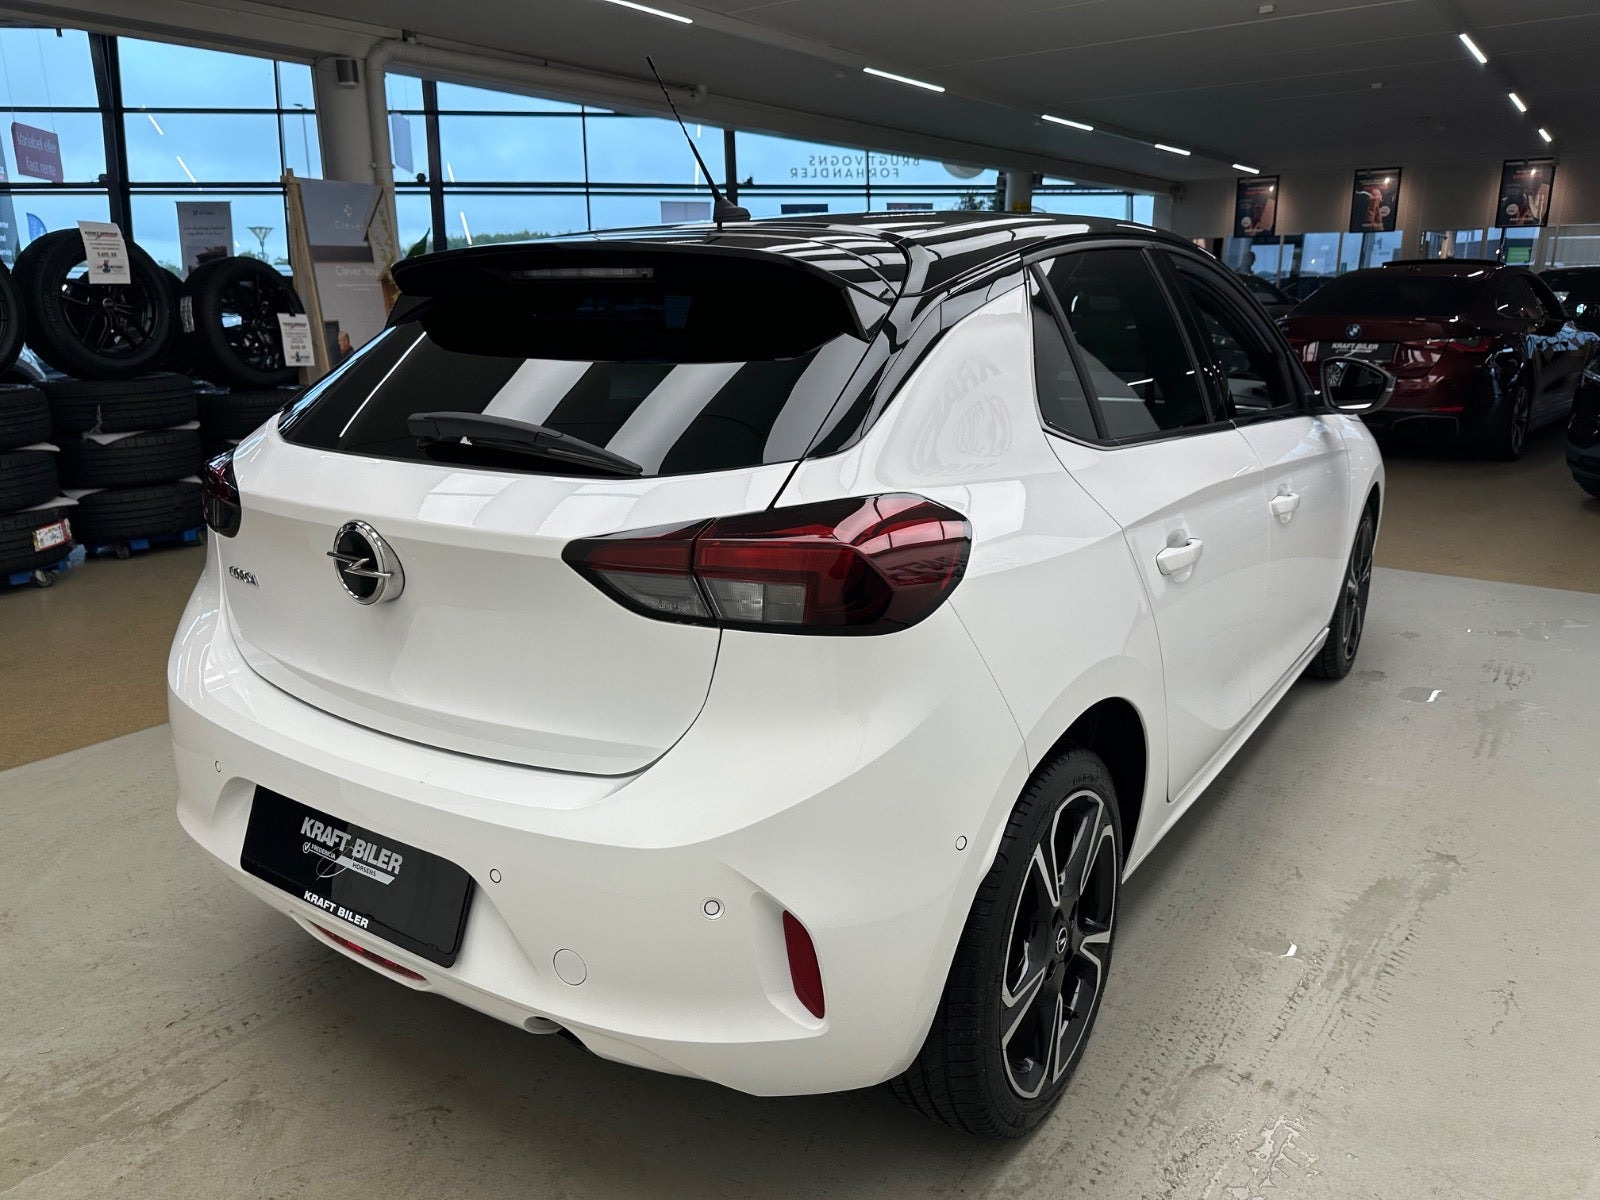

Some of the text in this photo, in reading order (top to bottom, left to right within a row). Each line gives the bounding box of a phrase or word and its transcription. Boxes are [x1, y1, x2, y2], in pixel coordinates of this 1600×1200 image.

[300, 816, 403, 875] KRAFT BILER
[352, 862, 377, 877] HORSENS
[303, 890, 369, 929] KRAFT BILER
